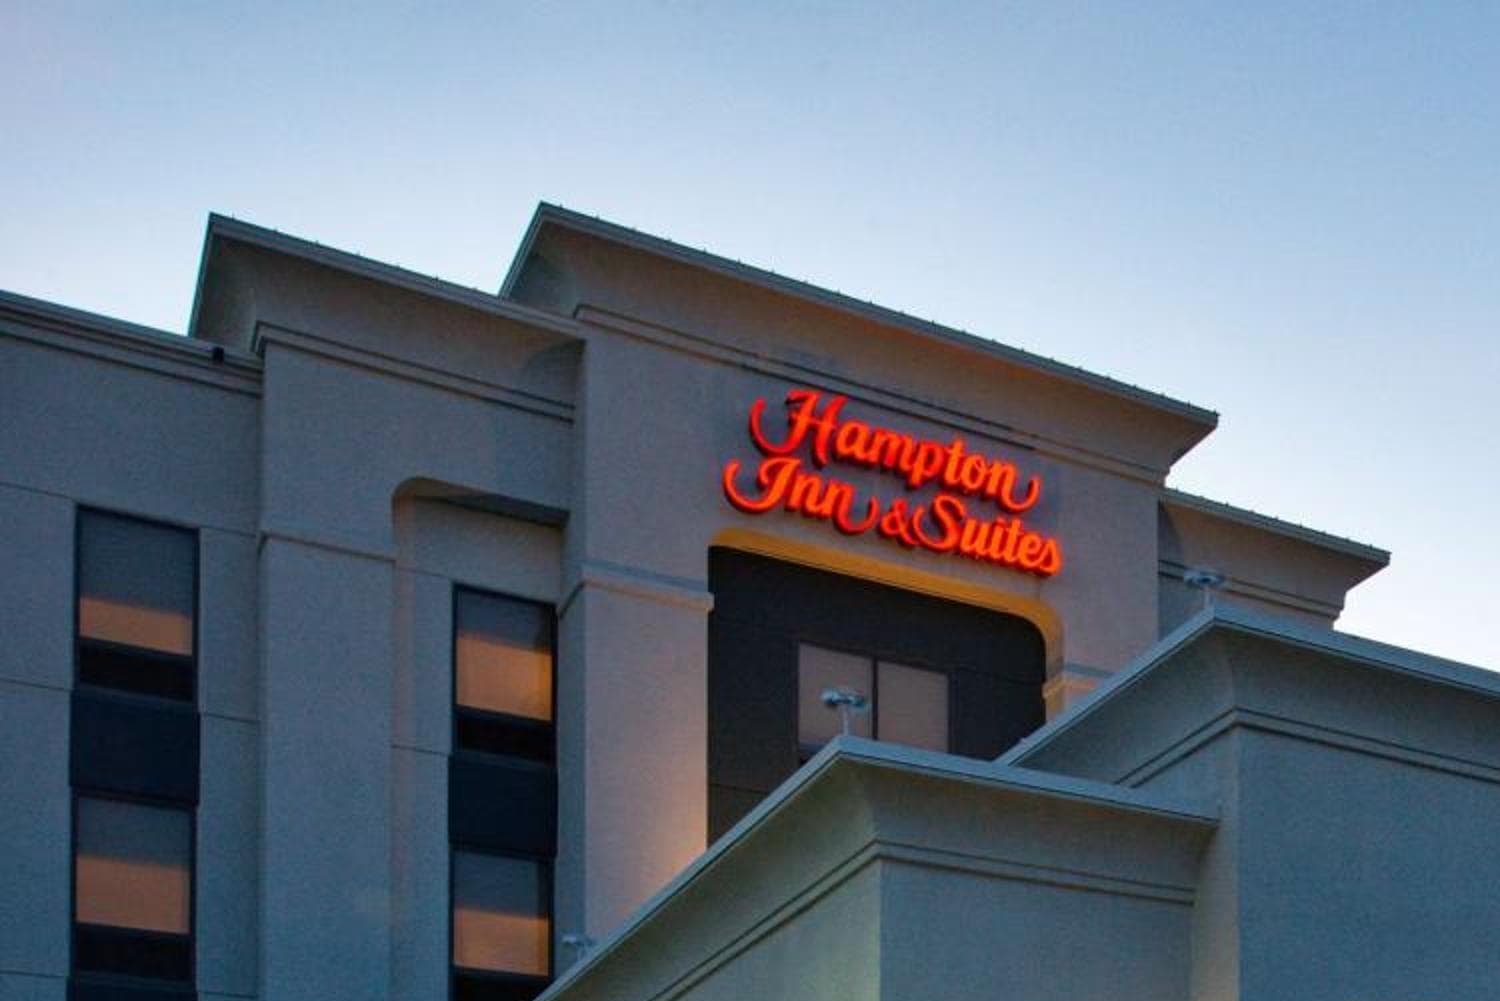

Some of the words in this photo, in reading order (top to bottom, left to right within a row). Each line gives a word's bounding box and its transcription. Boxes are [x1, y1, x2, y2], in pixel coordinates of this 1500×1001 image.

[749, 389, 1041, 513] Hampton
[723, 456, 881, 535] Inn
[879, 500, 918, 545] &
[912, 494, 1063, 577] Suites
